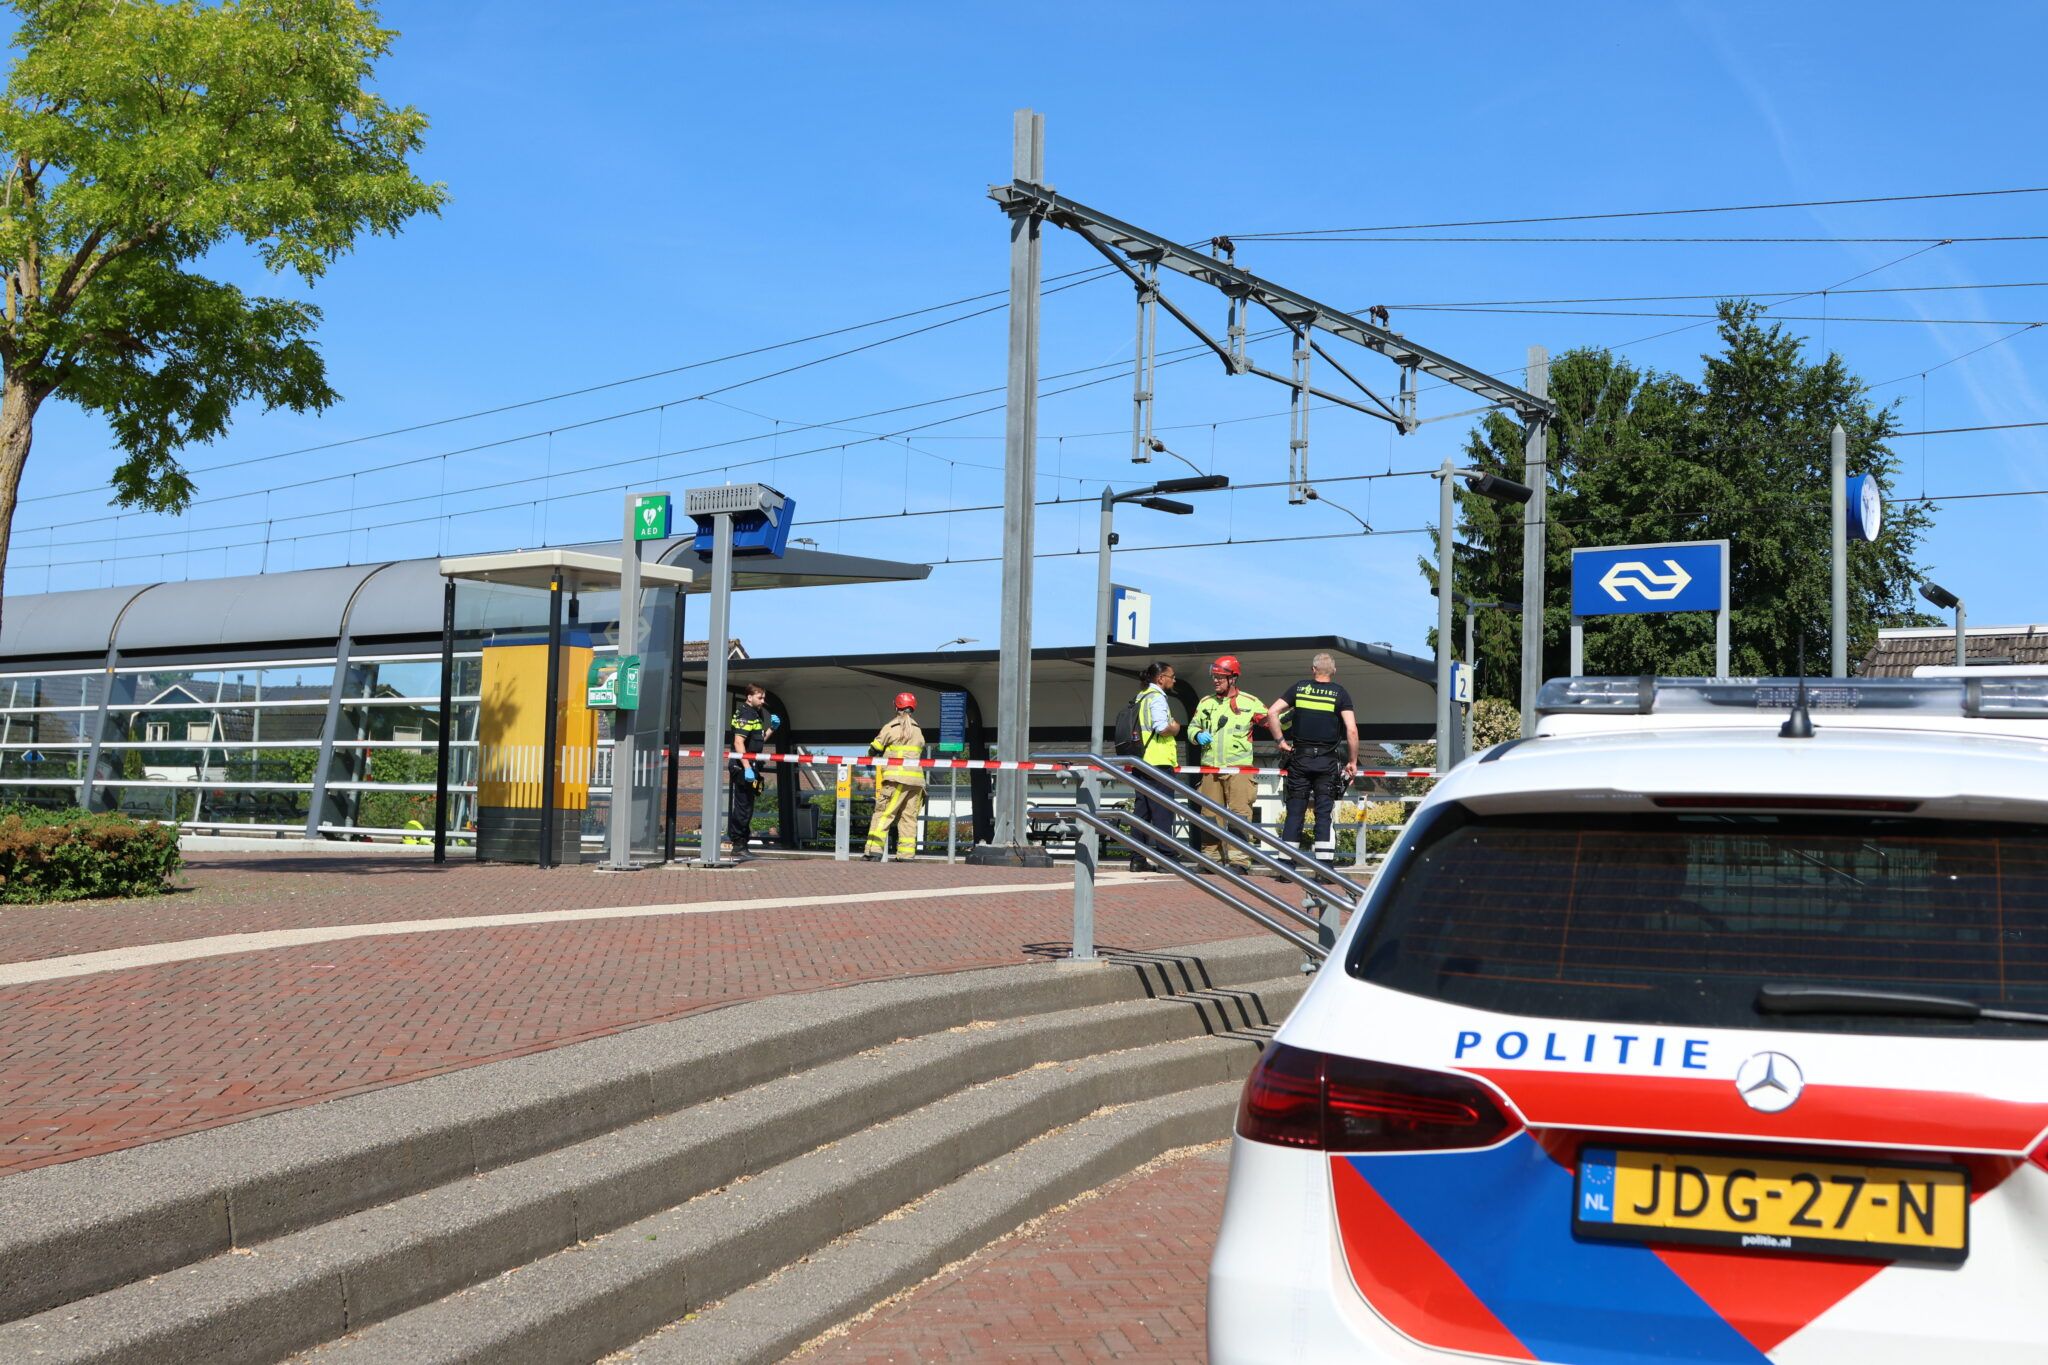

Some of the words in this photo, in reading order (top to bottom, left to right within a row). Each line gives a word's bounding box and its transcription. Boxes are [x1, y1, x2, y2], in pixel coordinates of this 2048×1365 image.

[641, 527, 658, 536] AED
[1128, 611, 1137, 640] 1
[1460, 677, 1467, 698] 2
[1454, 1031, 1710, 1070] POLITIE
[1585, 1193, 1610, 1212] NL
[1633, 1163, 1936, 1236] JDG-27-N
[1742, 1234, 1792, 1248] politie.nl
